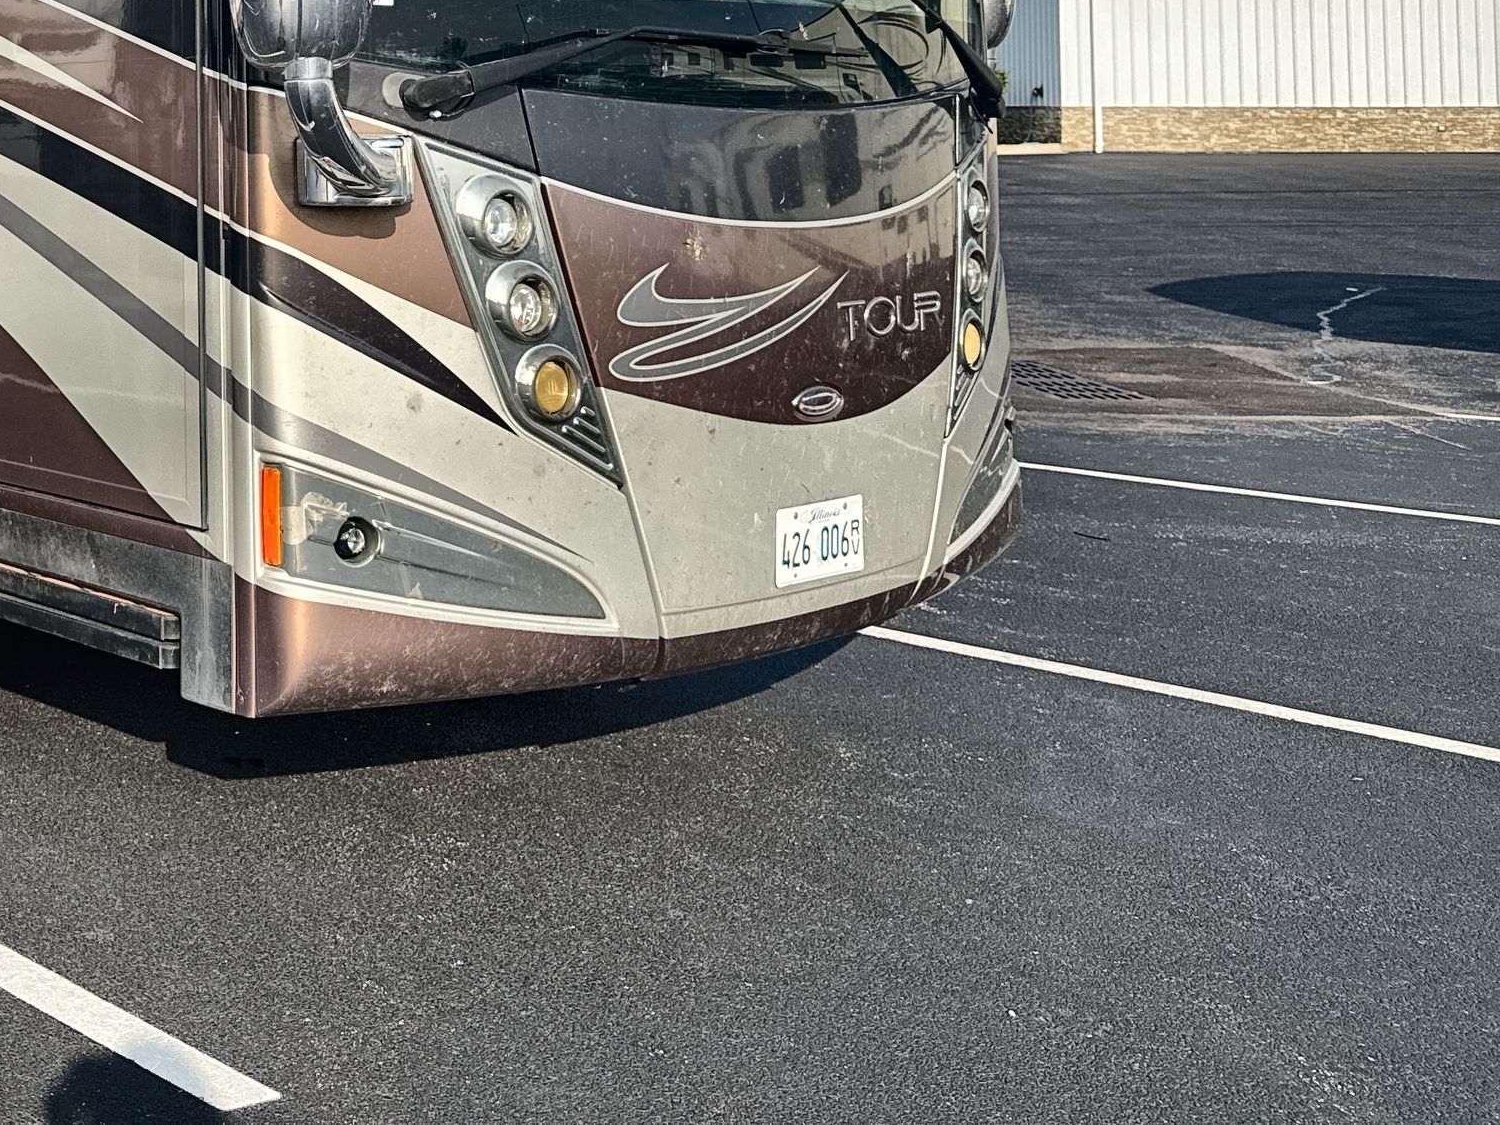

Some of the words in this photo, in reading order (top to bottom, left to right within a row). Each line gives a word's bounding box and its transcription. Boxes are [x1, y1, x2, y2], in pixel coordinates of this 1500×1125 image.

[837, 291, 941, 341] TOUR
[809, 507, 840, 523] Illinois
[782, 528, 811, 569] 426
[821, 521, 849, 561] 006
